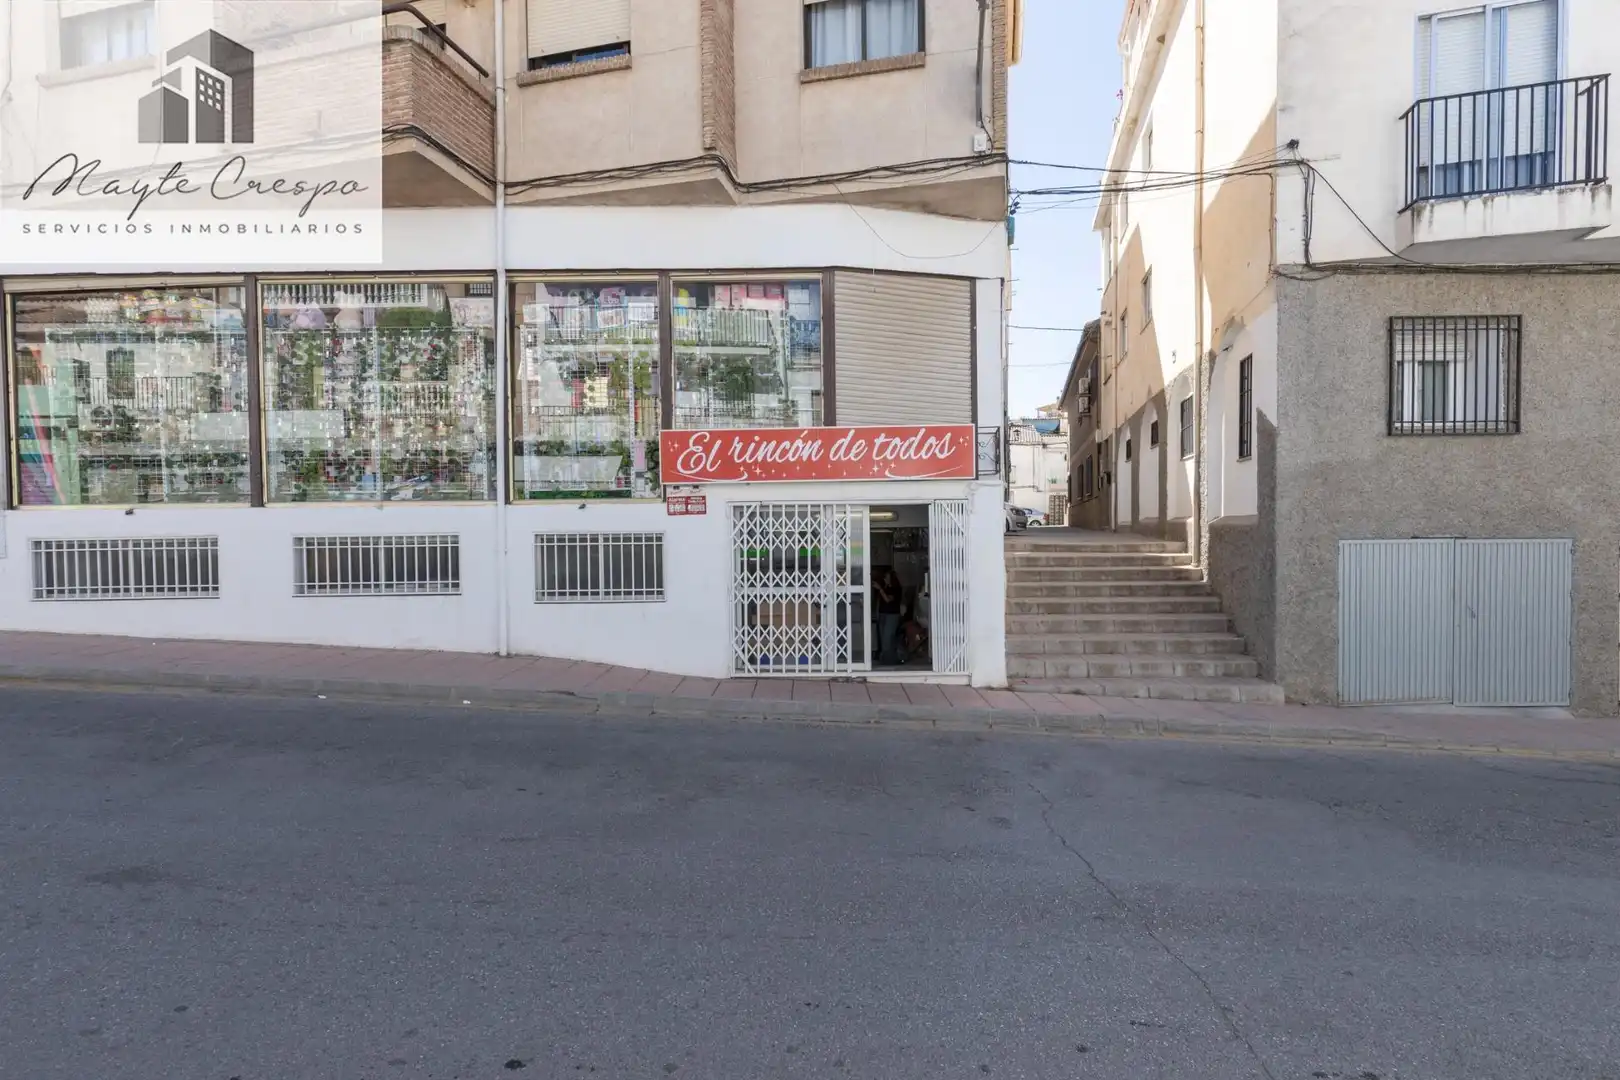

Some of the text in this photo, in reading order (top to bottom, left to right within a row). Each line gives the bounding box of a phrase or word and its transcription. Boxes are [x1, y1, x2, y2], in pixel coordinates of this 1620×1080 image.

[676, 428, 955, 474] El rincón de todos
